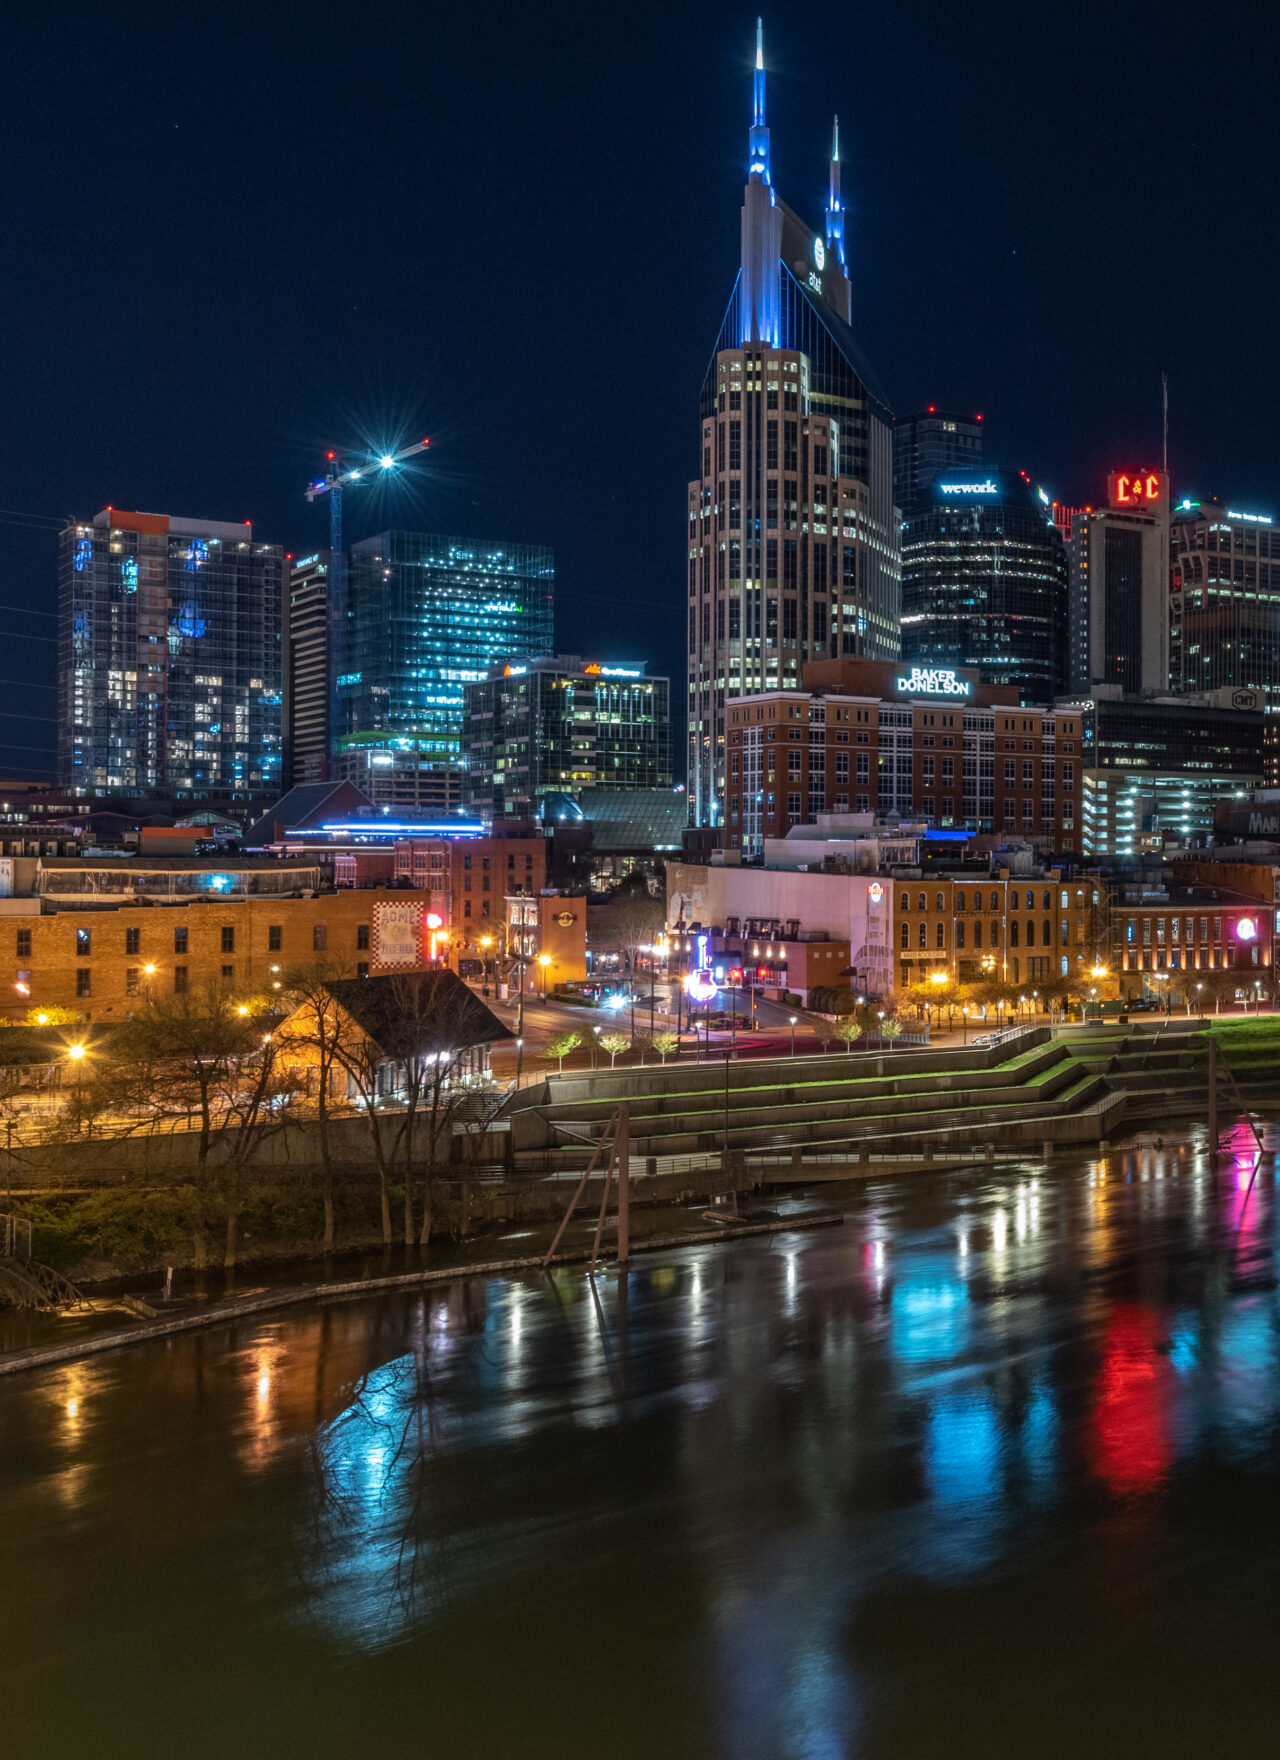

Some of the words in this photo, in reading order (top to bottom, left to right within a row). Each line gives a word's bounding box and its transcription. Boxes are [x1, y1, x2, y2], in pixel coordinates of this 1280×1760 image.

[941, 479, 998, 493] wework
[911, 667, 956, 683] BAKER
[897, 678, 970, 695] DONELSON
